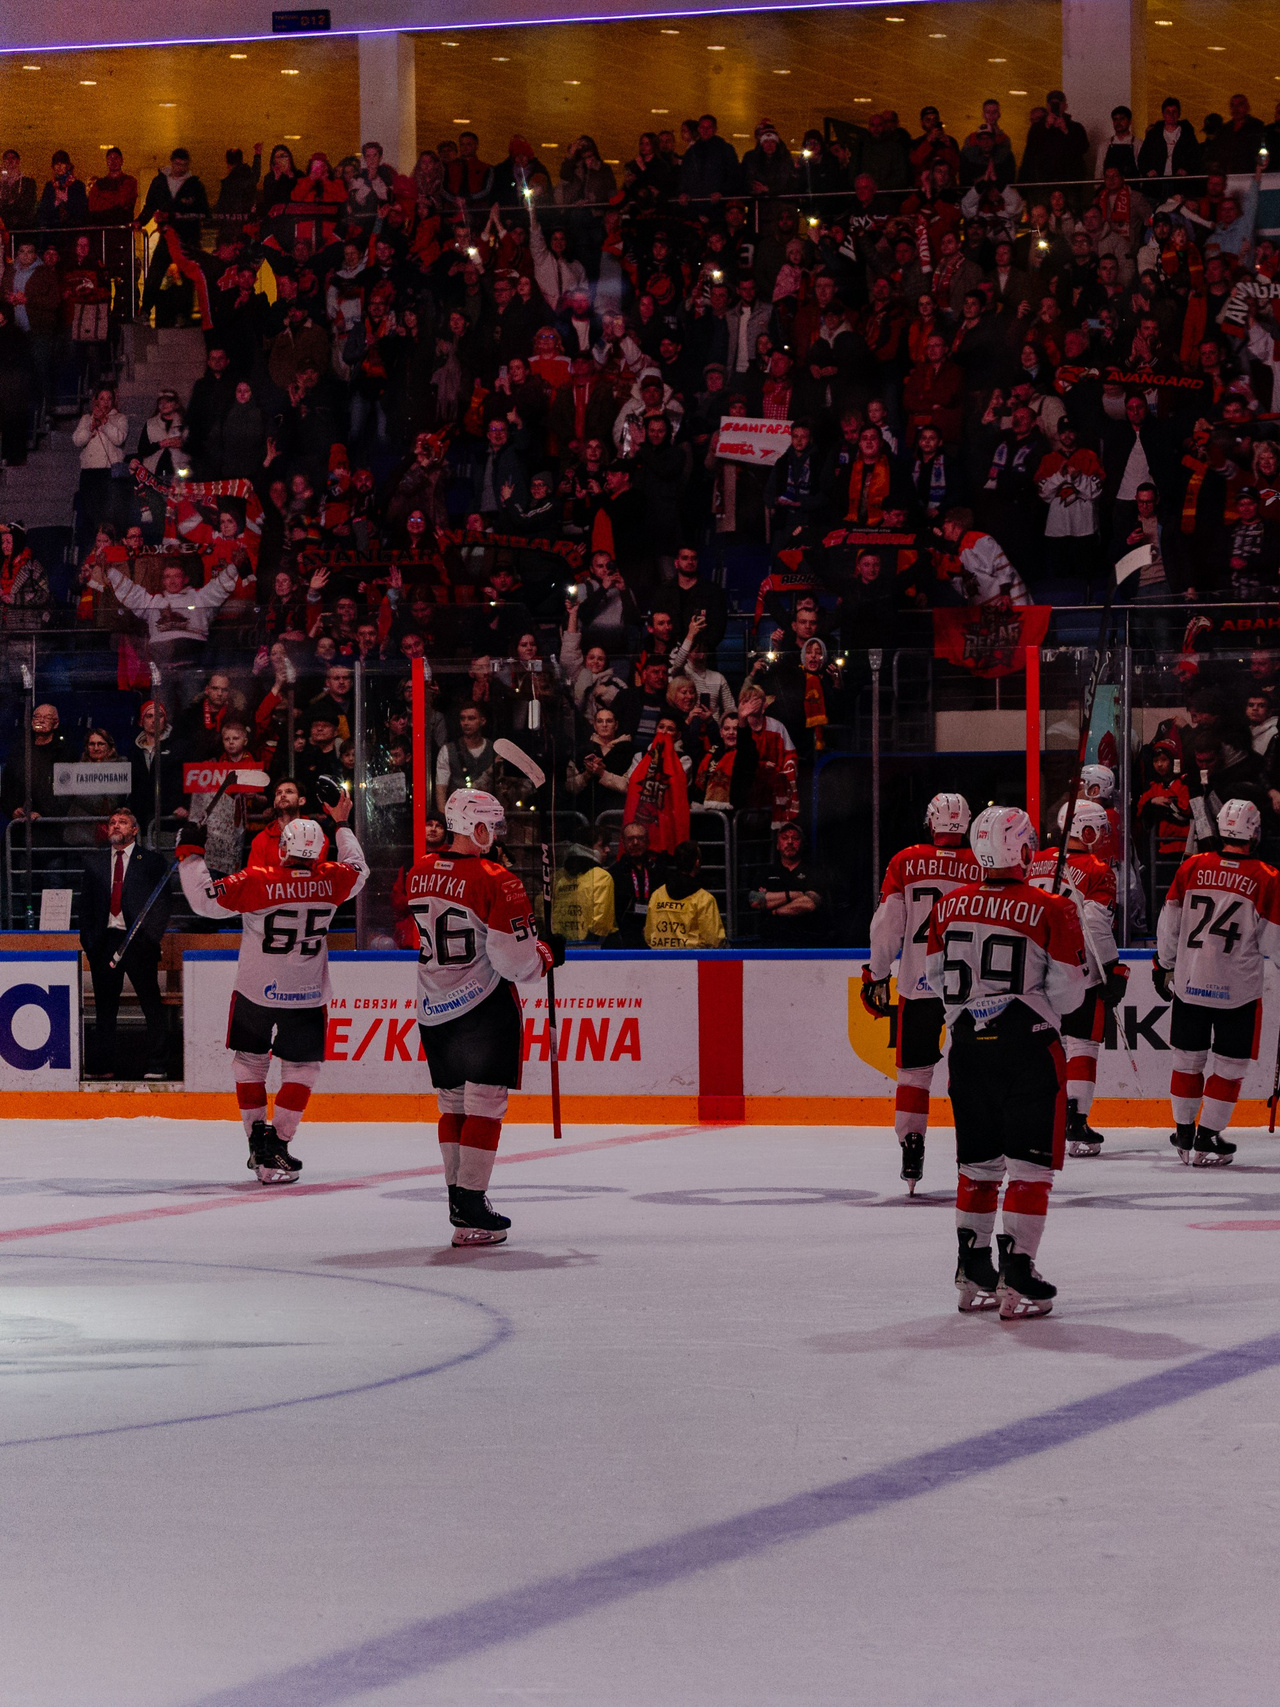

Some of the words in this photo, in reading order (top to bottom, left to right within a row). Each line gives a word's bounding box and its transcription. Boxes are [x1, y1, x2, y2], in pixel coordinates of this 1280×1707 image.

[1106, 370, 1205, 389] AVANGARD
[76, 773, 129, 783] ГАЗПРОМБАНК
[541, 843, 552, 901] CCM
[905, 858, 988, 882] KABLUKOV
[981, 855, 994, 867] 59
[265, 879, 333, 900] YAKUPOV
[410, 874, 467, 899] CHAYKA
[1196, 869, 1258, 895] SOLOVYEV
[656, 902, 685, 910] SAFETY
[936, 895, 1045, 928] VORONKOV
[262, 909, 332, 955] 65
[410, 904, 477, 966] 56
[510, 913, 538, 943] 56
[1187, 895, 1242, 954] 24
[651, 938, 689, 948] SAFETY
[943, 930, 1028, 1005] 59
[330, 998, 347, 1009] НА
[354, 998, 398, 1009] СВЯЗИ
[433, 985, 485, 1016] ГАЗПРОМНЕФТЬ
